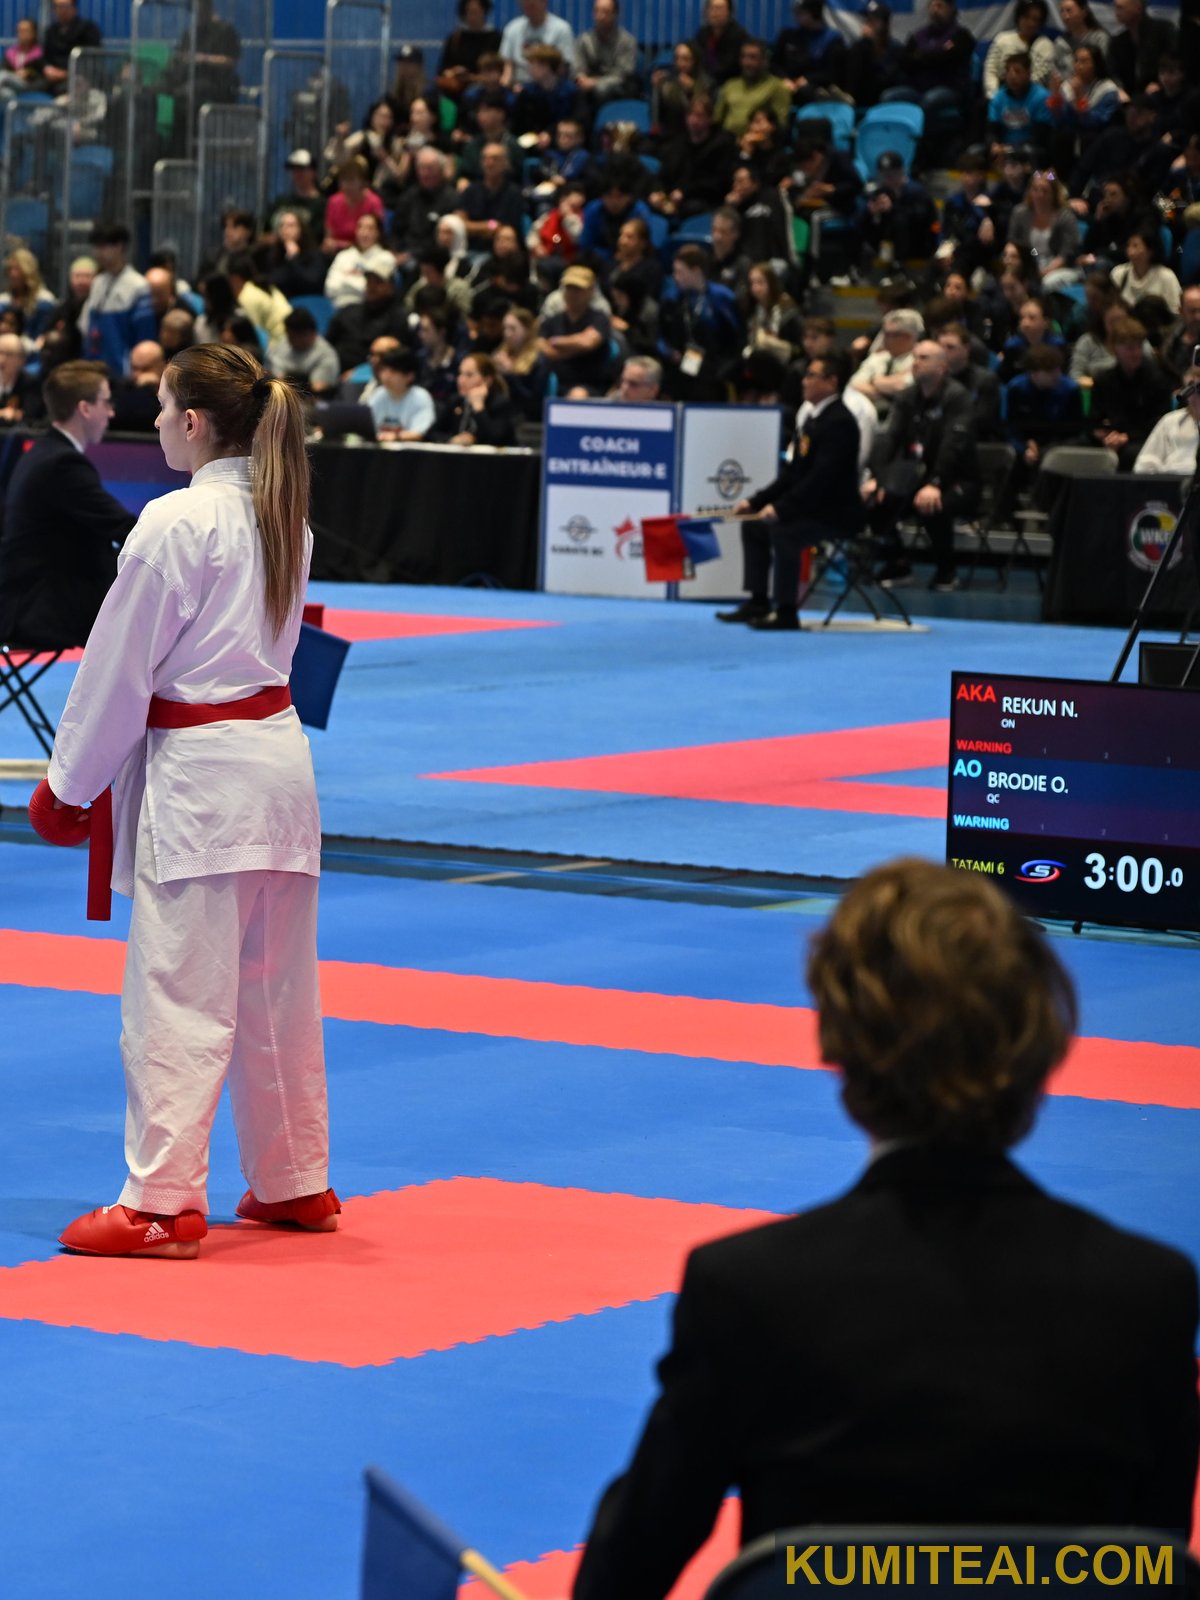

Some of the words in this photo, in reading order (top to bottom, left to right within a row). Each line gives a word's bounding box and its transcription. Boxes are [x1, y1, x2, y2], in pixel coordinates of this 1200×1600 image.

[580, 435, 640, 454] COACH
[956, 683, 997, 703] AKA
[1002, 696, 1056, 716] REKUN
[1061, 700, 1079, 718] N.
[1001, 718, 1016, 729] ON
[956, 739, 1013, 754] WARNING
[953, 758, 982, 778] AO
[987, 771, 1047, 792] BRODIE
[1051, 776, 1069, 794] O.
[986, 793, 1000, 805] QC
[953, 814, 1010, 831] WARNING
[951, 858, 994, 874] TATAMI
[997, 862, 1005, 875] 6
[1083, 852, 1184, 894] 3:00.0
[143, 1232, 169, 1243] adidas
